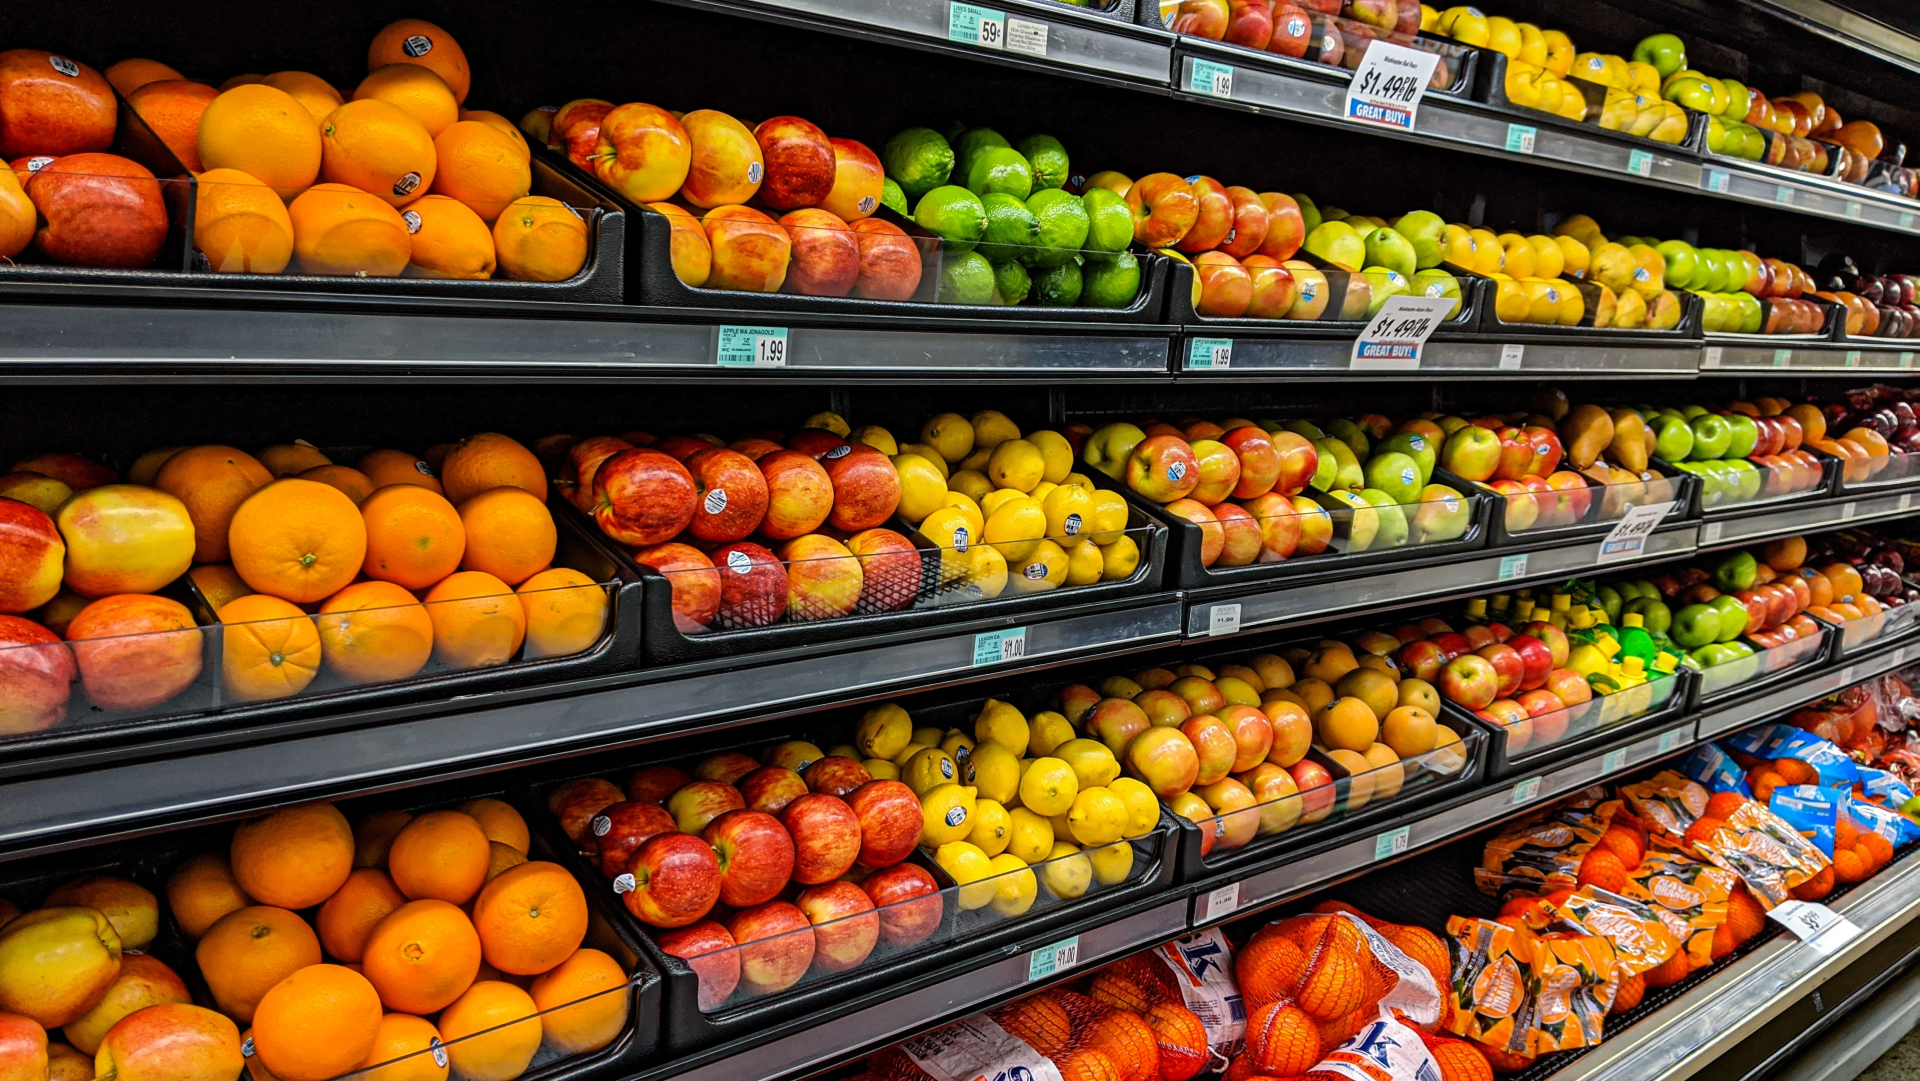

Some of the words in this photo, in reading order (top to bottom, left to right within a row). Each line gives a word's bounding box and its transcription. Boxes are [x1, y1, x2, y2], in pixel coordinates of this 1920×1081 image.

[968, 6, 982, 15] SMALL
[1216, 76, 1229, 94] 1.99
[1360, 67, 1403, 99] $1.49
[1356, 104, 1384, 120] GREAT
[1385, 110, 1406, 124] BUY!
[1371, 316, 1416, 337] $1.49
[761, 340, 783, 361] 1.99
[1215, 348, 1229, 365] 1.99
[1364, 345, 1392, 356] GREAT
[1392, 345, 1412, 356] BUY!
